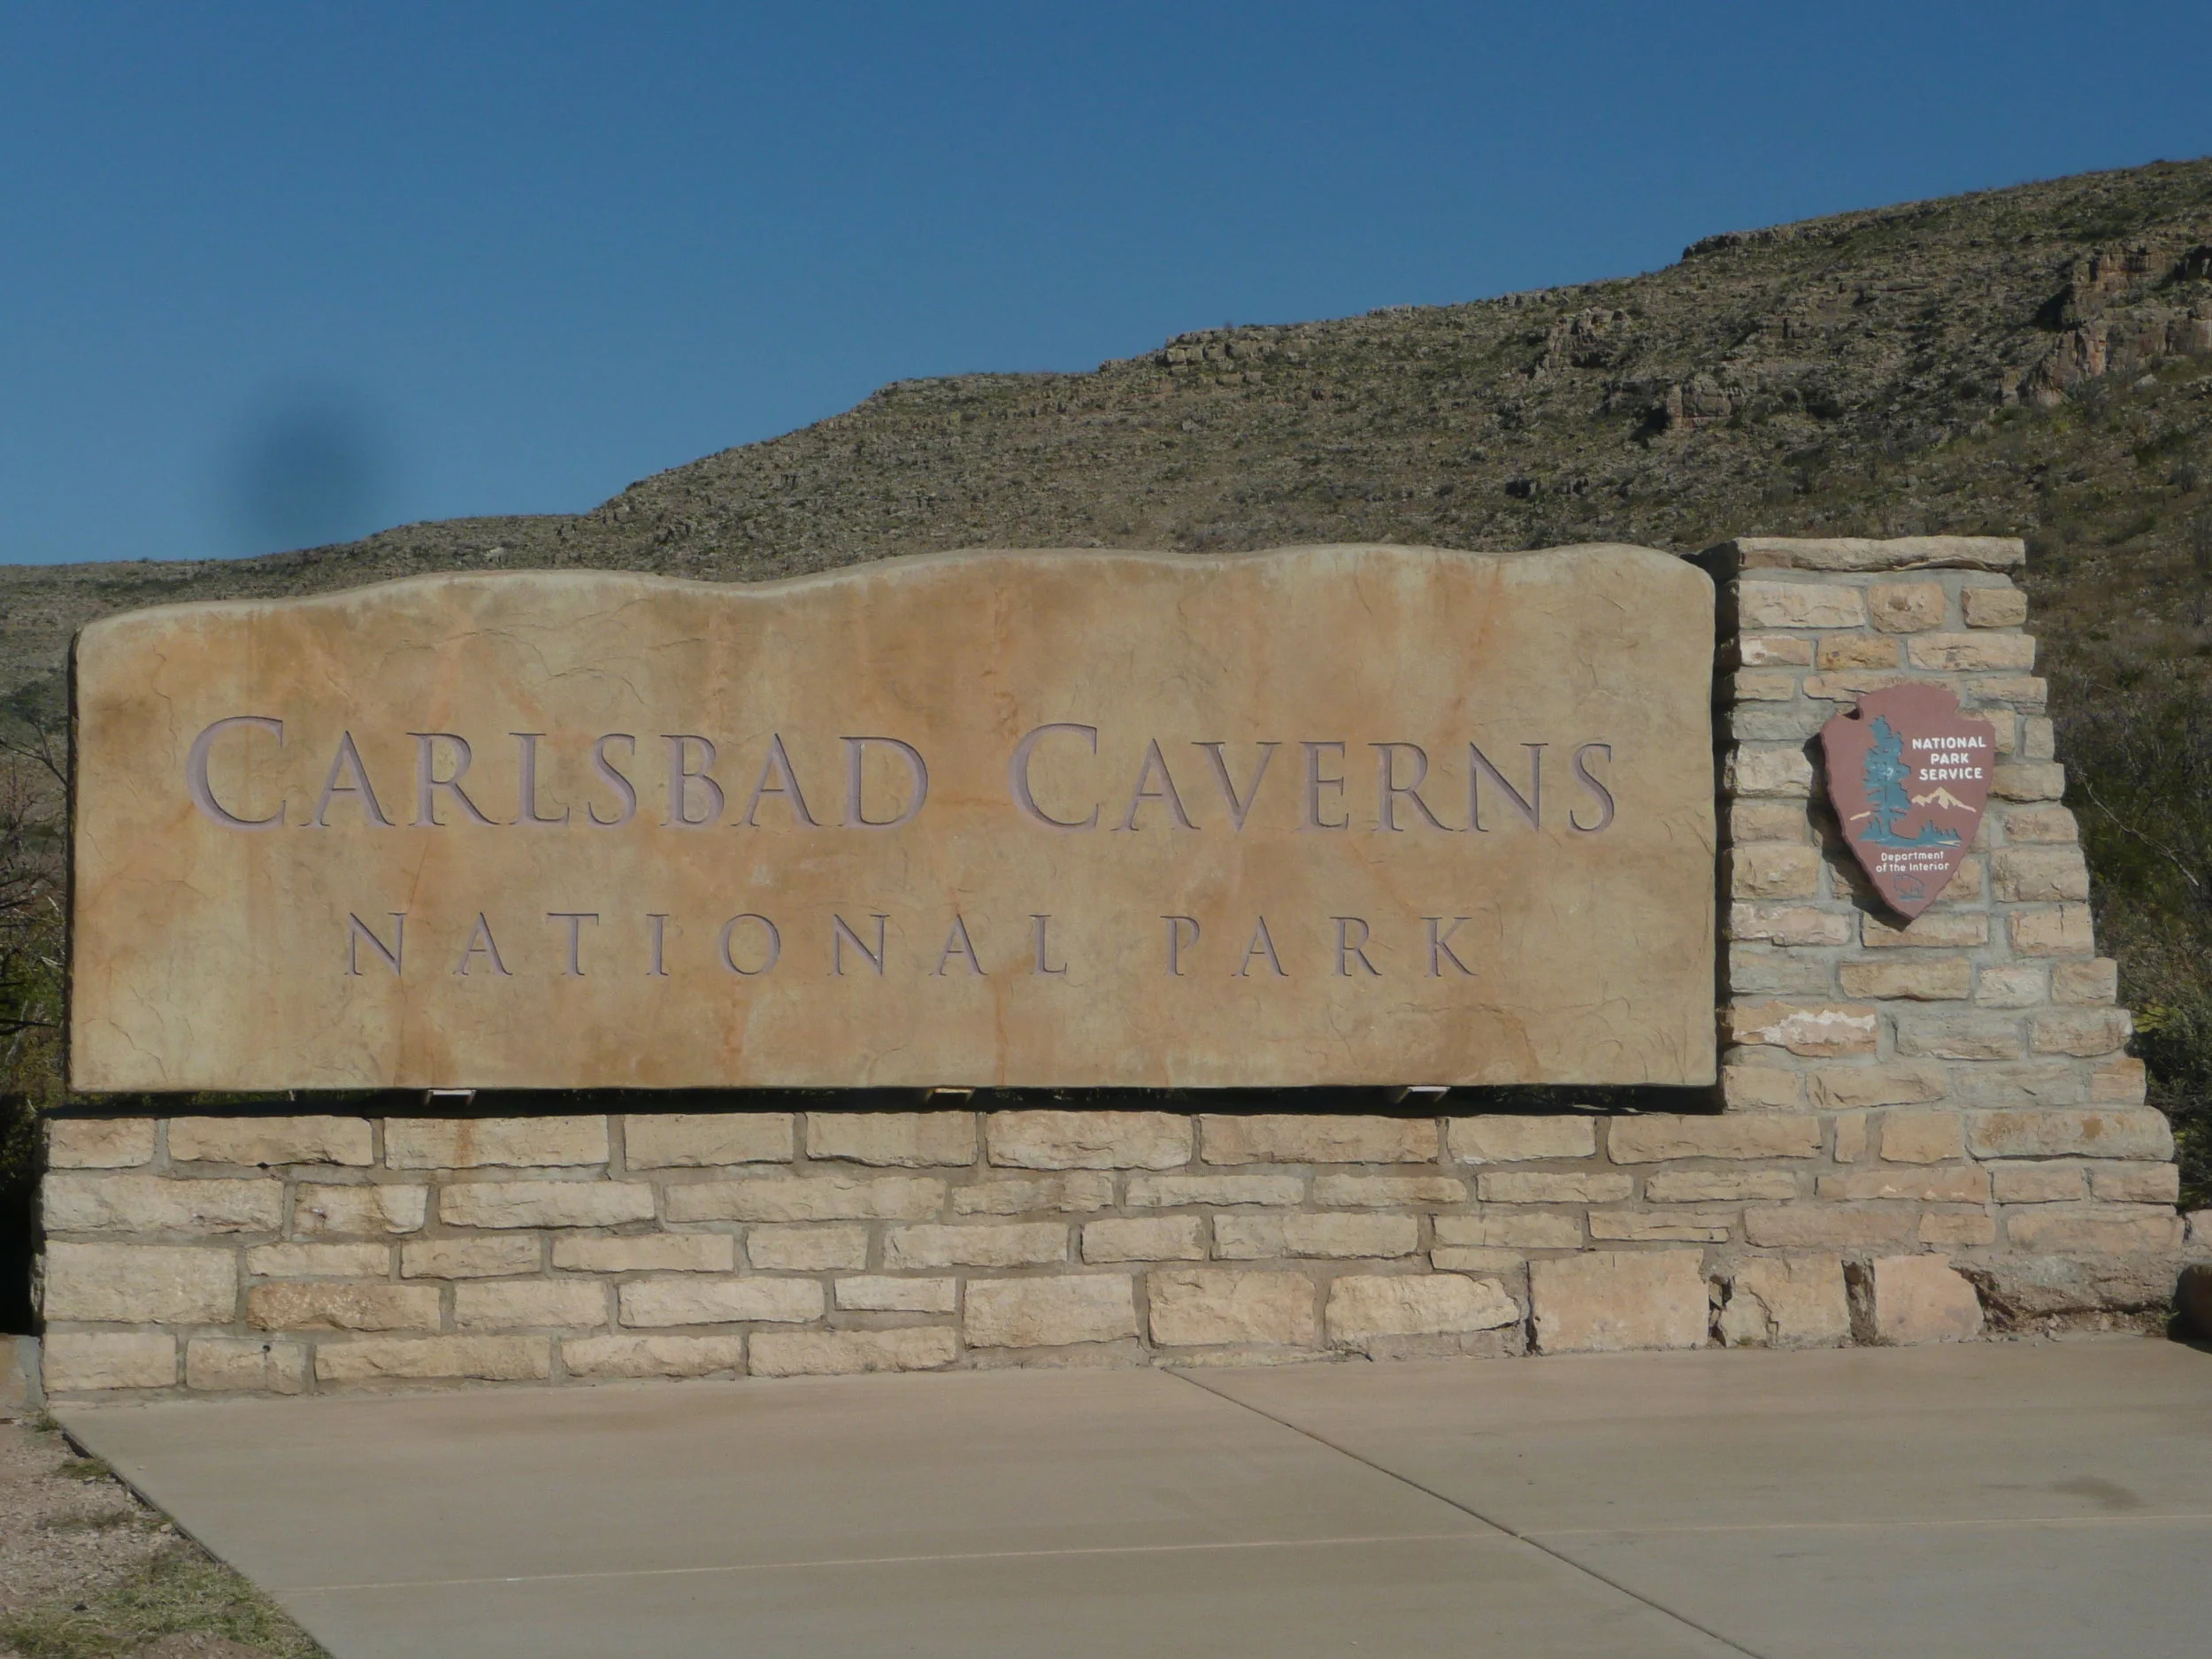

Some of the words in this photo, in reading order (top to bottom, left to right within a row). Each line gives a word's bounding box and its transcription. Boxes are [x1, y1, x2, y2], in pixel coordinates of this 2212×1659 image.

[1912, 735, 1986, 749] NATIONAL
[1930, 753, 1970, 765] PARK
[185, 715, 929, 831] CARLSBAD
[1007, 722, 1616, 835] CAVERNS
[1918, 767, 1983, 780] SERVICE
[1880, 850, 1944, 863] Department
[1876, 863, 1888, 872] of
[1890, 863, 1906, 872] the
[1909, 862, 1950, 872] Interior
[343, 912, 1068, 979] NATIONAL
[1160, 915, 1479, 979] PARK
